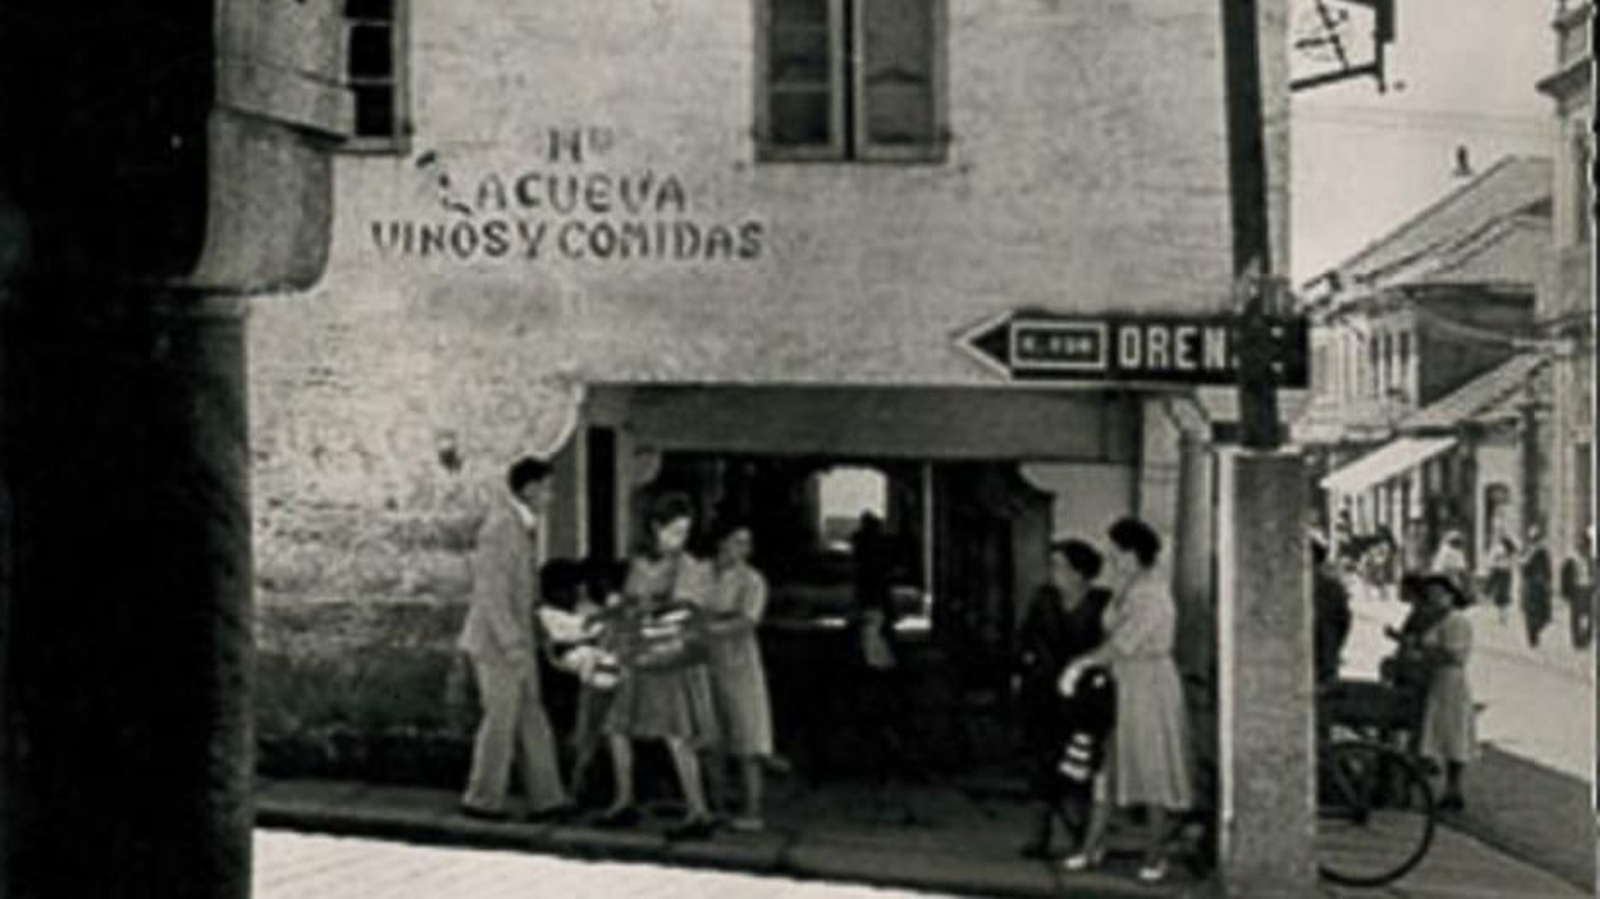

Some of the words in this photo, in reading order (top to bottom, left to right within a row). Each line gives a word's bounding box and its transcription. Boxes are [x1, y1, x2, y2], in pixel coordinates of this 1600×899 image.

[371, 220, 509, 259] VINOS
[517, 220, 547, 259] Y
[558, 220, 763, 260] COMIDAS
